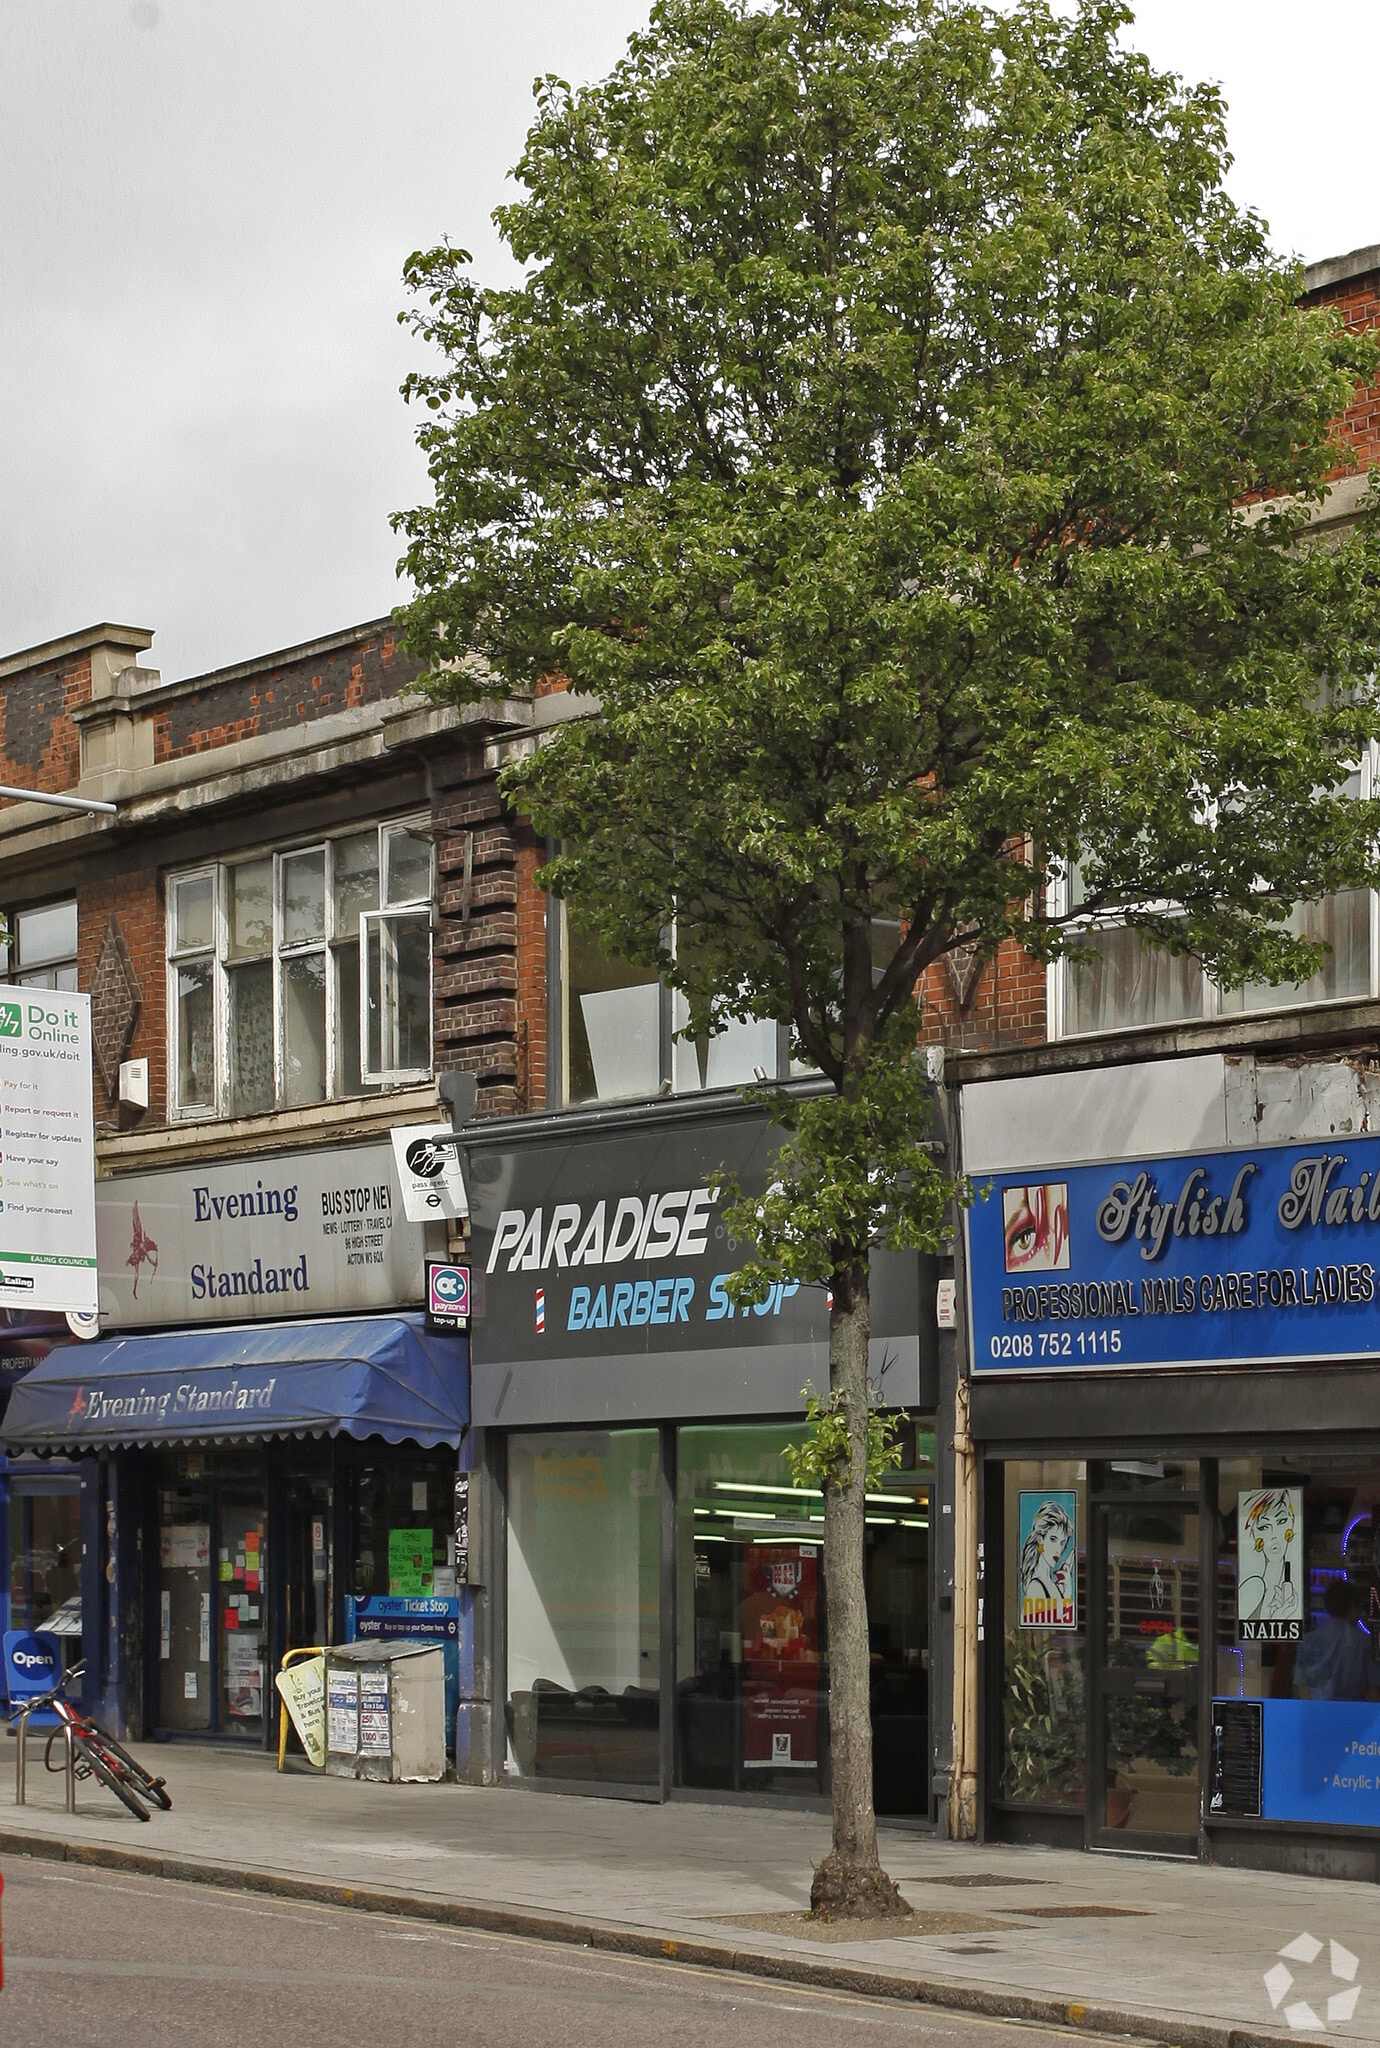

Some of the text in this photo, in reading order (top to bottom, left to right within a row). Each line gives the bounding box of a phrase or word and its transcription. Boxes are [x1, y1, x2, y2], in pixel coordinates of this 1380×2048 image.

[28, 1005, 79, 1028] Do it
[29, 1026, 80, 1044] Online
[4, 1080, 18, 1090] Pay
[5, 1105, 31, 1114] Report
[43, 1110, 72, 1118] request
[5, 1129, 82, 1143] Register for updates
[6, 1154, 59, 1167] Have your say
[412, 1181, 427, 1190] pass
[7, 1203, 24, 1211] Find
[26, 1205, 43, 1213] your
[193, 1180, 299, 1223] Evening
[321, 1190, 342, 1216] BUS
[344, 1187, 370, 1214] STOP
[1096, 1161, 1260, 1261] Stylish
[322, 1221, 338, 1235] NEWS
[340, 1219, 363, 1234] LOTTERY
[366, 1216, 386, 1231] TRAVEL
[485, 1187, 720, 1274] PARADISE
[352, 1235, 364, 1249] HIGH
[364, 1233, 383, 1247] STREET
[31, 1255, 89, 1267] EALING COUNCIL
[347, 1252, 365, 1266] ACTON
[4, 1277, 33, 1288] Ealing
[191, 1255, 310, 1299] Standard
[1002, 1262, 1377, 1322] PROFESSIONAL NAILS CARE FOR LADIES
[434, 1302, 466, 1312] payzone
[567, 1277, 696, 1332] BARBER
[433, 1316, 456, 1326] top-up
[990, 1329, 1123, 1359] 0208 752 1115
[84, 1378, 277, 1421] Evening Standard
[378, 1598, 449, 1615] oyster Ticket Stop
[1022, 1596, 1074, 1624] NAILS
[360, 1620, 381, 1632] oyster
[411, 1624, 420, 1632] your
[421, 1623, 434, 1632] Oyster
[1139, 1620, 1174, 1635] OPEN
[1241, 1621, 1301, 1640] NAILS
[13, 1651, 54, 1668] Open
[293, 1691, 306, 1703] Buy
[307, 1686, 322, 1699] your
[308, 1708, 321, 1718] Bus
[304, 1718, 320, 1728] here
[1332, 1773, 1372, 1792] Acrylic
